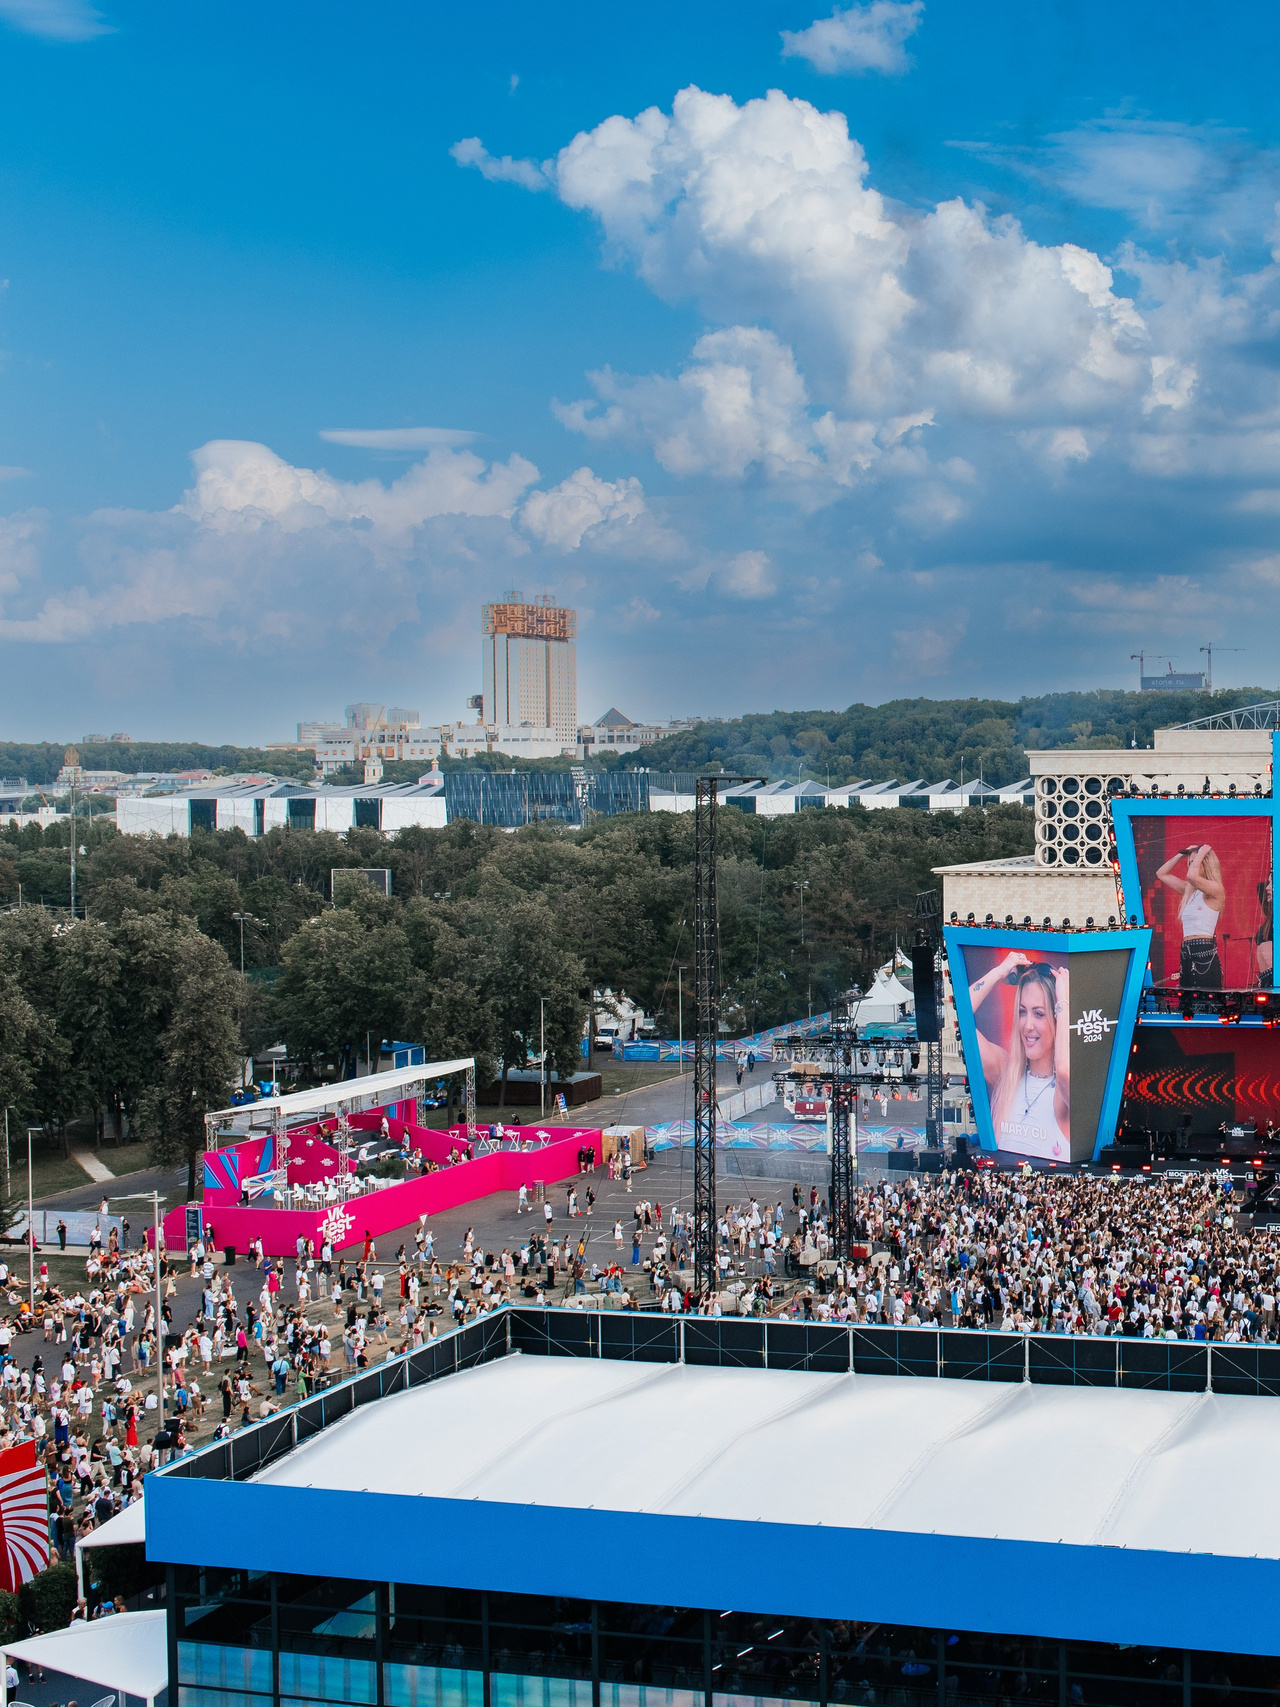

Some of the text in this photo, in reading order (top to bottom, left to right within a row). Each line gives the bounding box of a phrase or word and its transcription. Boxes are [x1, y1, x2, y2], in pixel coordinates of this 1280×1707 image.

[1082, 1009, 1103, 1022] VK
[1075, 1017, 1111, 1036] fest
[1083, 1034, 1102, 1043] 2024
[1000, 1121, 1048, 1140] MARY GU
[327, 1204, 346, 1222] VK
[317, 1213, 356, 1239] fest
[330, 1232, 346, 1245] 024
